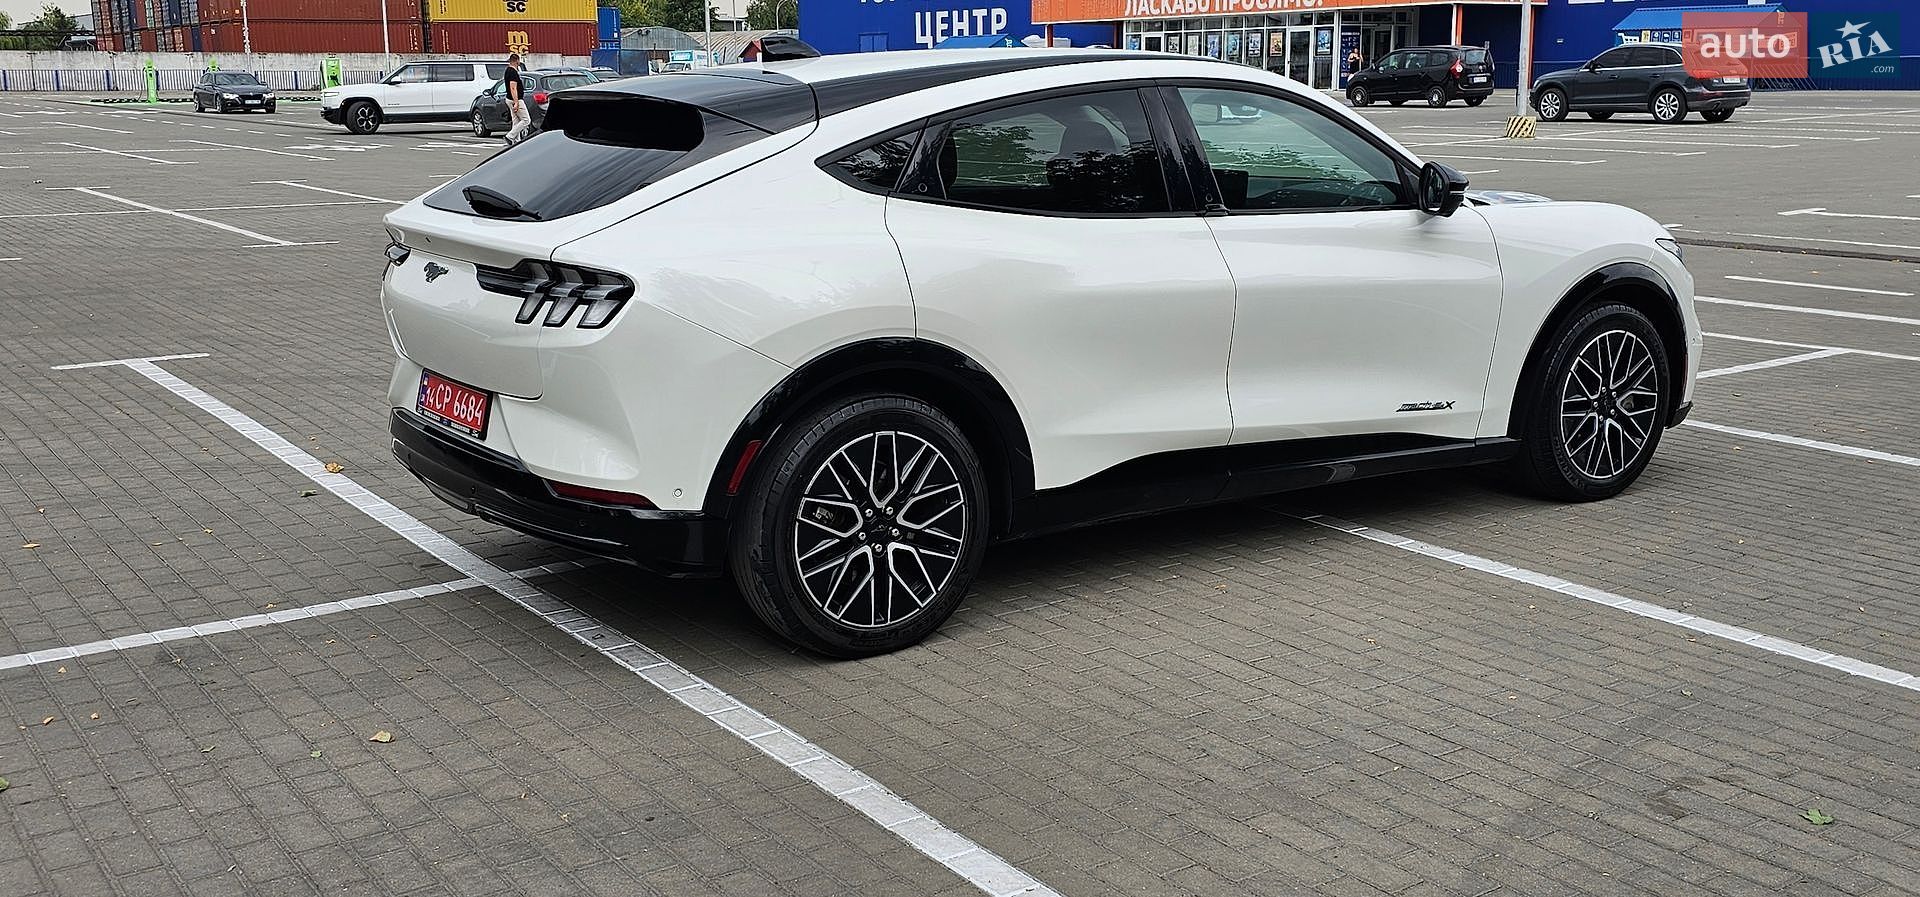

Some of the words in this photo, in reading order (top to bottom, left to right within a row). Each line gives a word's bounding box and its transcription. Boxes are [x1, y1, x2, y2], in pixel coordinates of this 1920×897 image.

[1124, 0, 1210, 17] ЛАСКАВО
[1215, 0, 1323, 12] ПРОС
[915, 8, 1007, 49] ЦЕНТР
[453, 390, 484, 426] 6684
